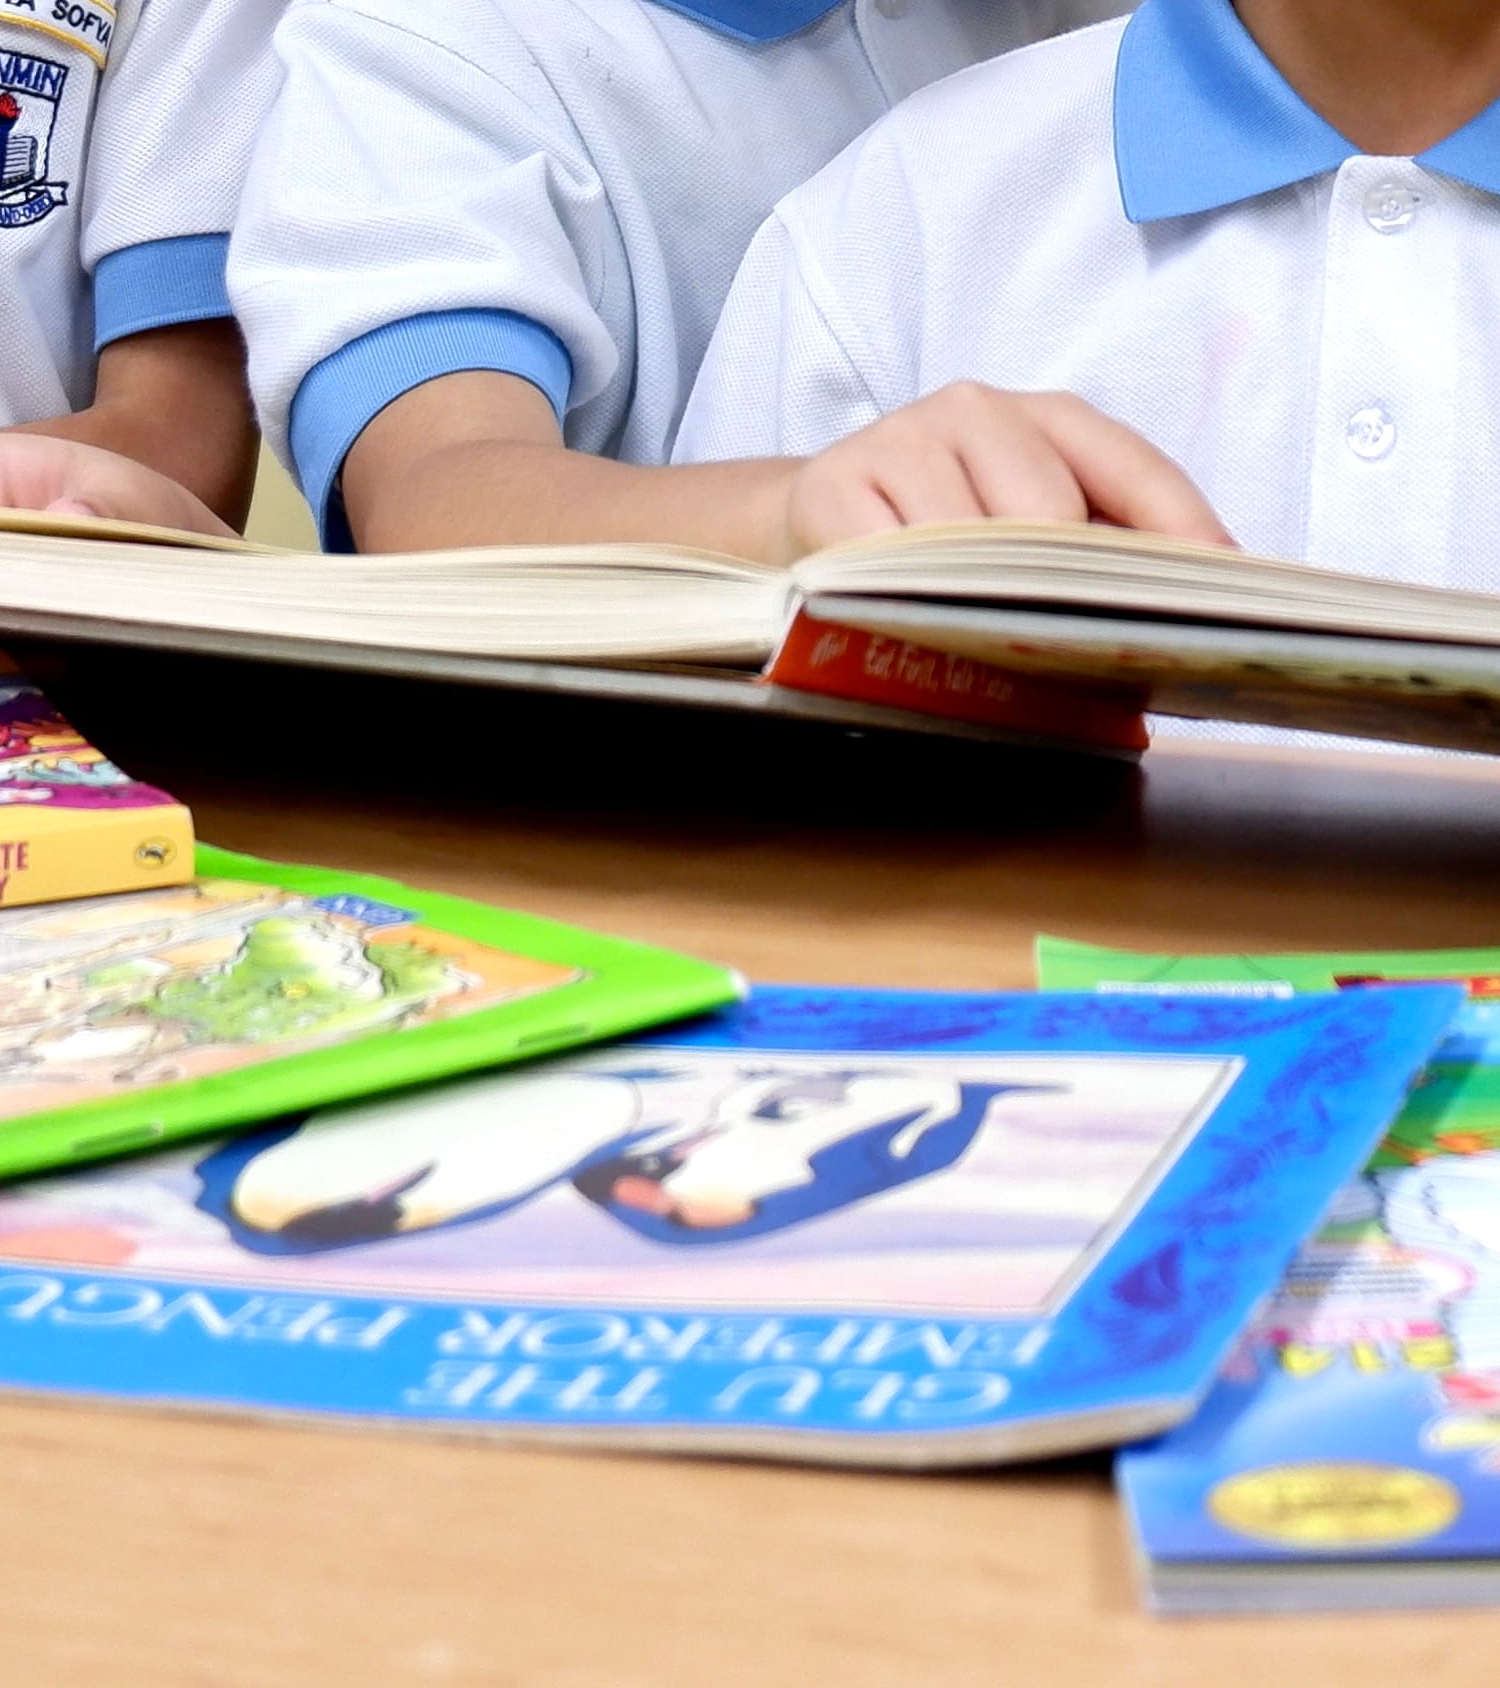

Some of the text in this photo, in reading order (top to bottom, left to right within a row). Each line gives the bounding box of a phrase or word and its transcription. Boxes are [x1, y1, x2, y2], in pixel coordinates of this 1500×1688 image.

[438, 1309, 1060, 1369] EMPEROR
[405, 1359, 1012, 1420] GLU THE
